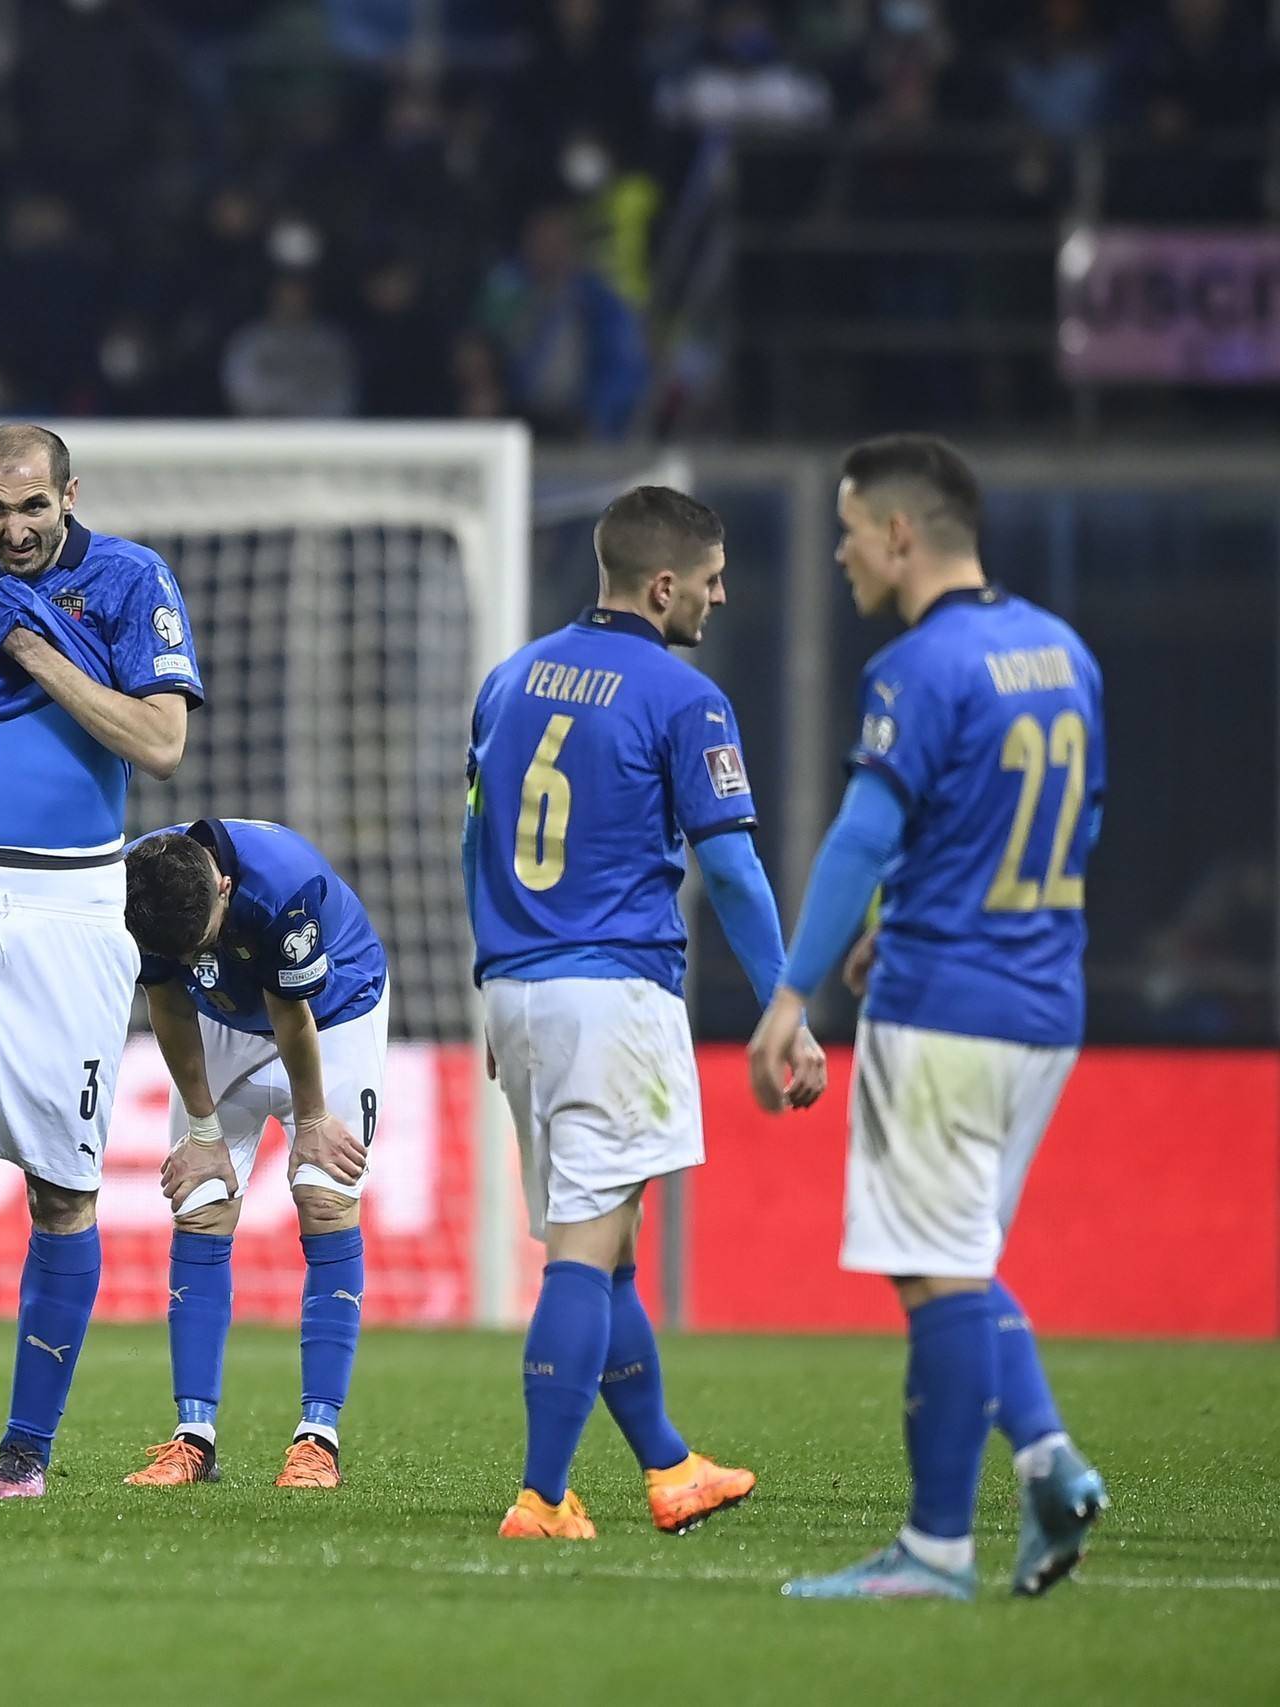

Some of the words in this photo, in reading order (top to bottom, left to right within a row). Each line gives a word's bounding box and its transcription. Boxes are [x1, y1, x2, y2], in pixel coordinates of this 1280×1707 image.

[524, 659, 623, 708] VERRATTI
[514, 713, 576, 892] 6
[982, 709, 1087, 912] 22
[78, 1059, 101, 1120] 3
[360, 1088, 378, 1148] 8
